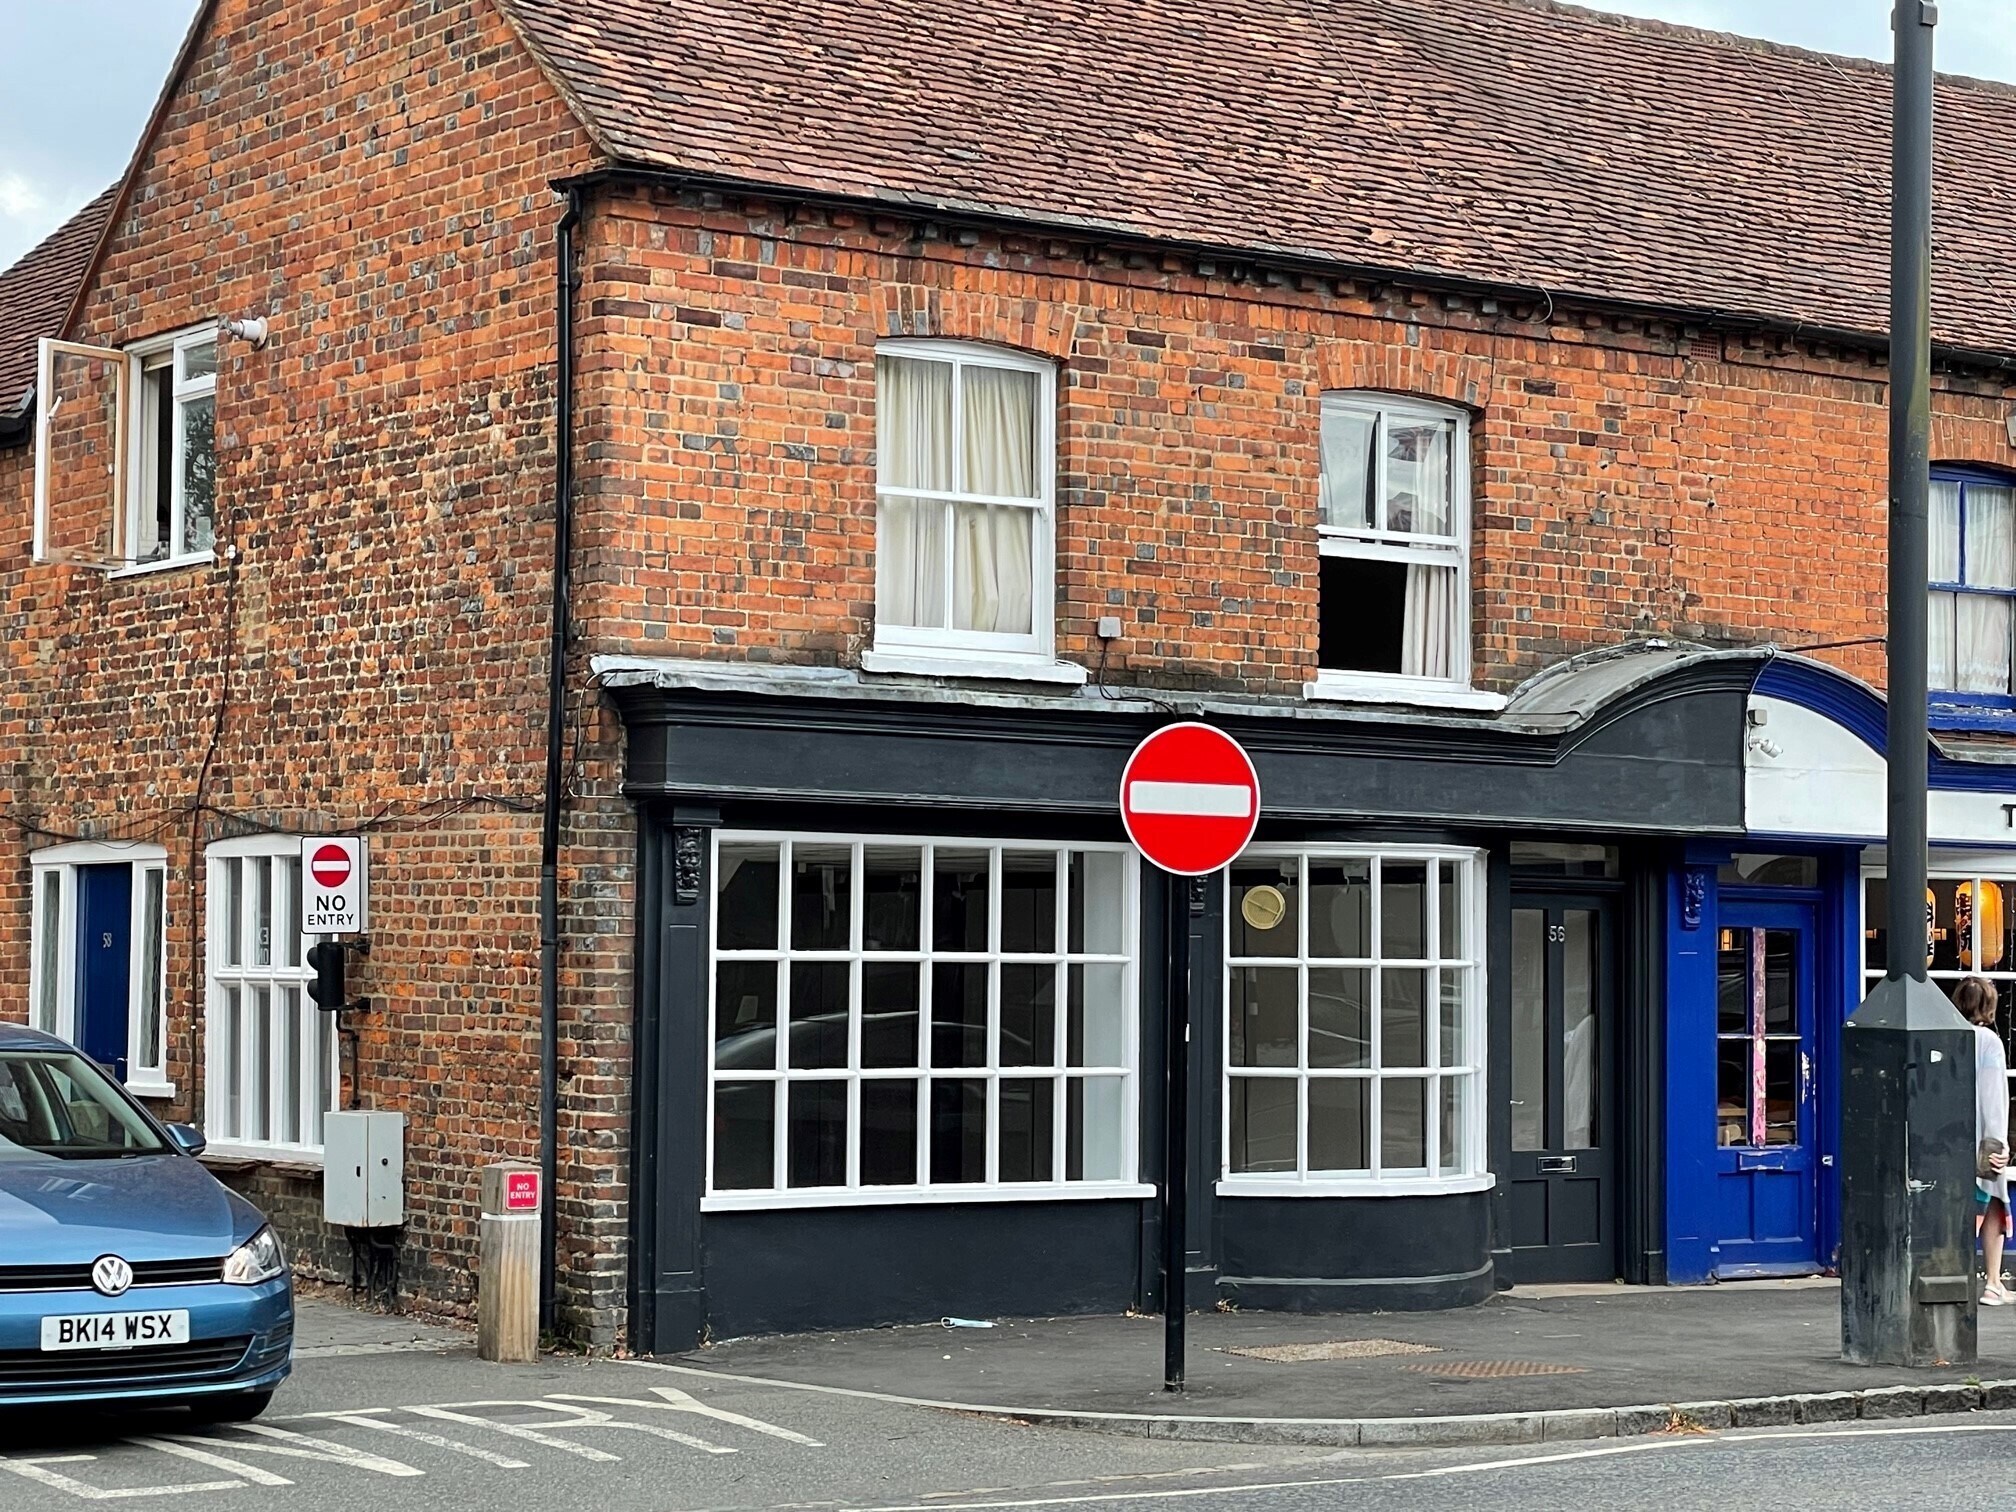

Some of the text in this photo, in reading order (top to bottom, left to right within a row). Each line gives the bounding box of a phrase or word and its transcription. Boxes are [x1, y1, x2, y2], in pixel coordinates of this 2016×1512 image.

[316, 894, 346, 912] NO
[307, 914, 354, 926] ENTRY
[1548, 925, 1565, 942] 56
[516, 1182, 530, 1191] NO
[510, 1191, 535, 1199] ENTRY
[58, 1314, 172, 1343] BK14 WSX
